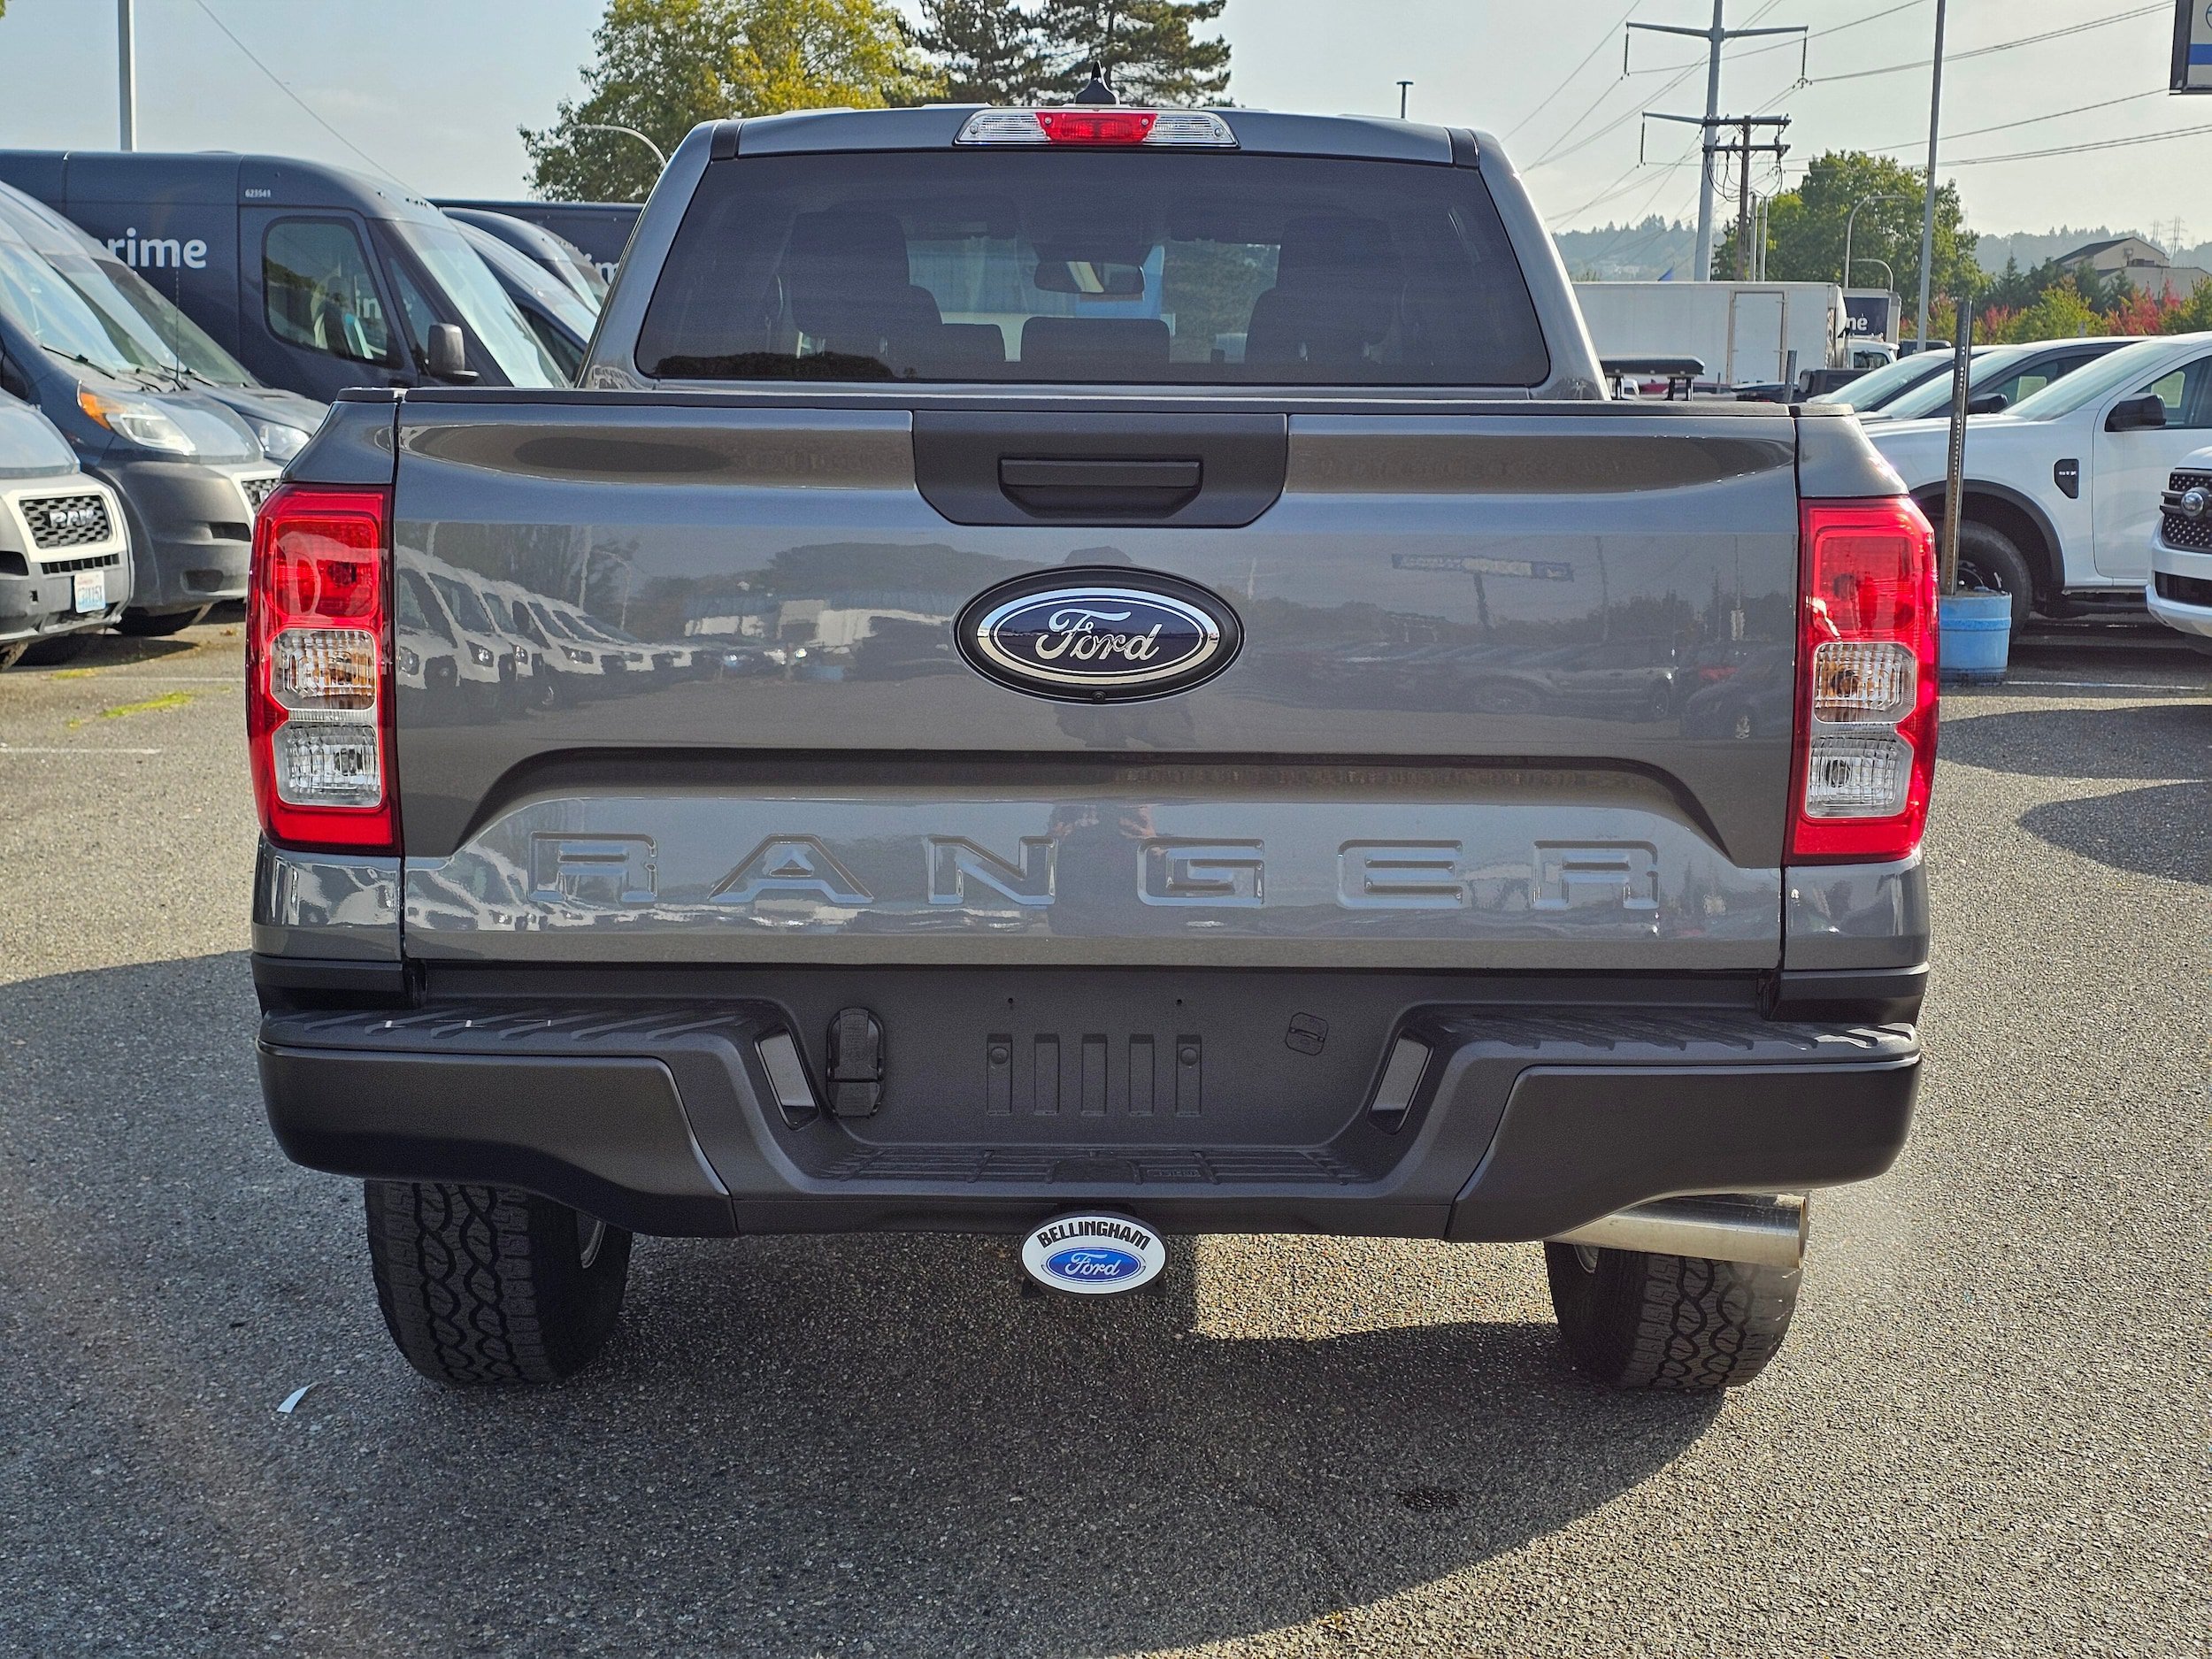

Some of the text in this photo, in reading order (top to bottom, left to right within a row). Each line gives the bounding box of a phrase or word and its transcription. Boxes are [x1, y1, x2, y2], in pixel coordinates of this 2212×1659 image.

[107, 227, 208, 269] rime
[1034, 608, 1163, 661] Ford
[529, 831, 1661, 910] RANGER
[1036, 1221, 1151, 1251] BELLINGHAM
[1064, 1252, 1122, 1276] Ford
